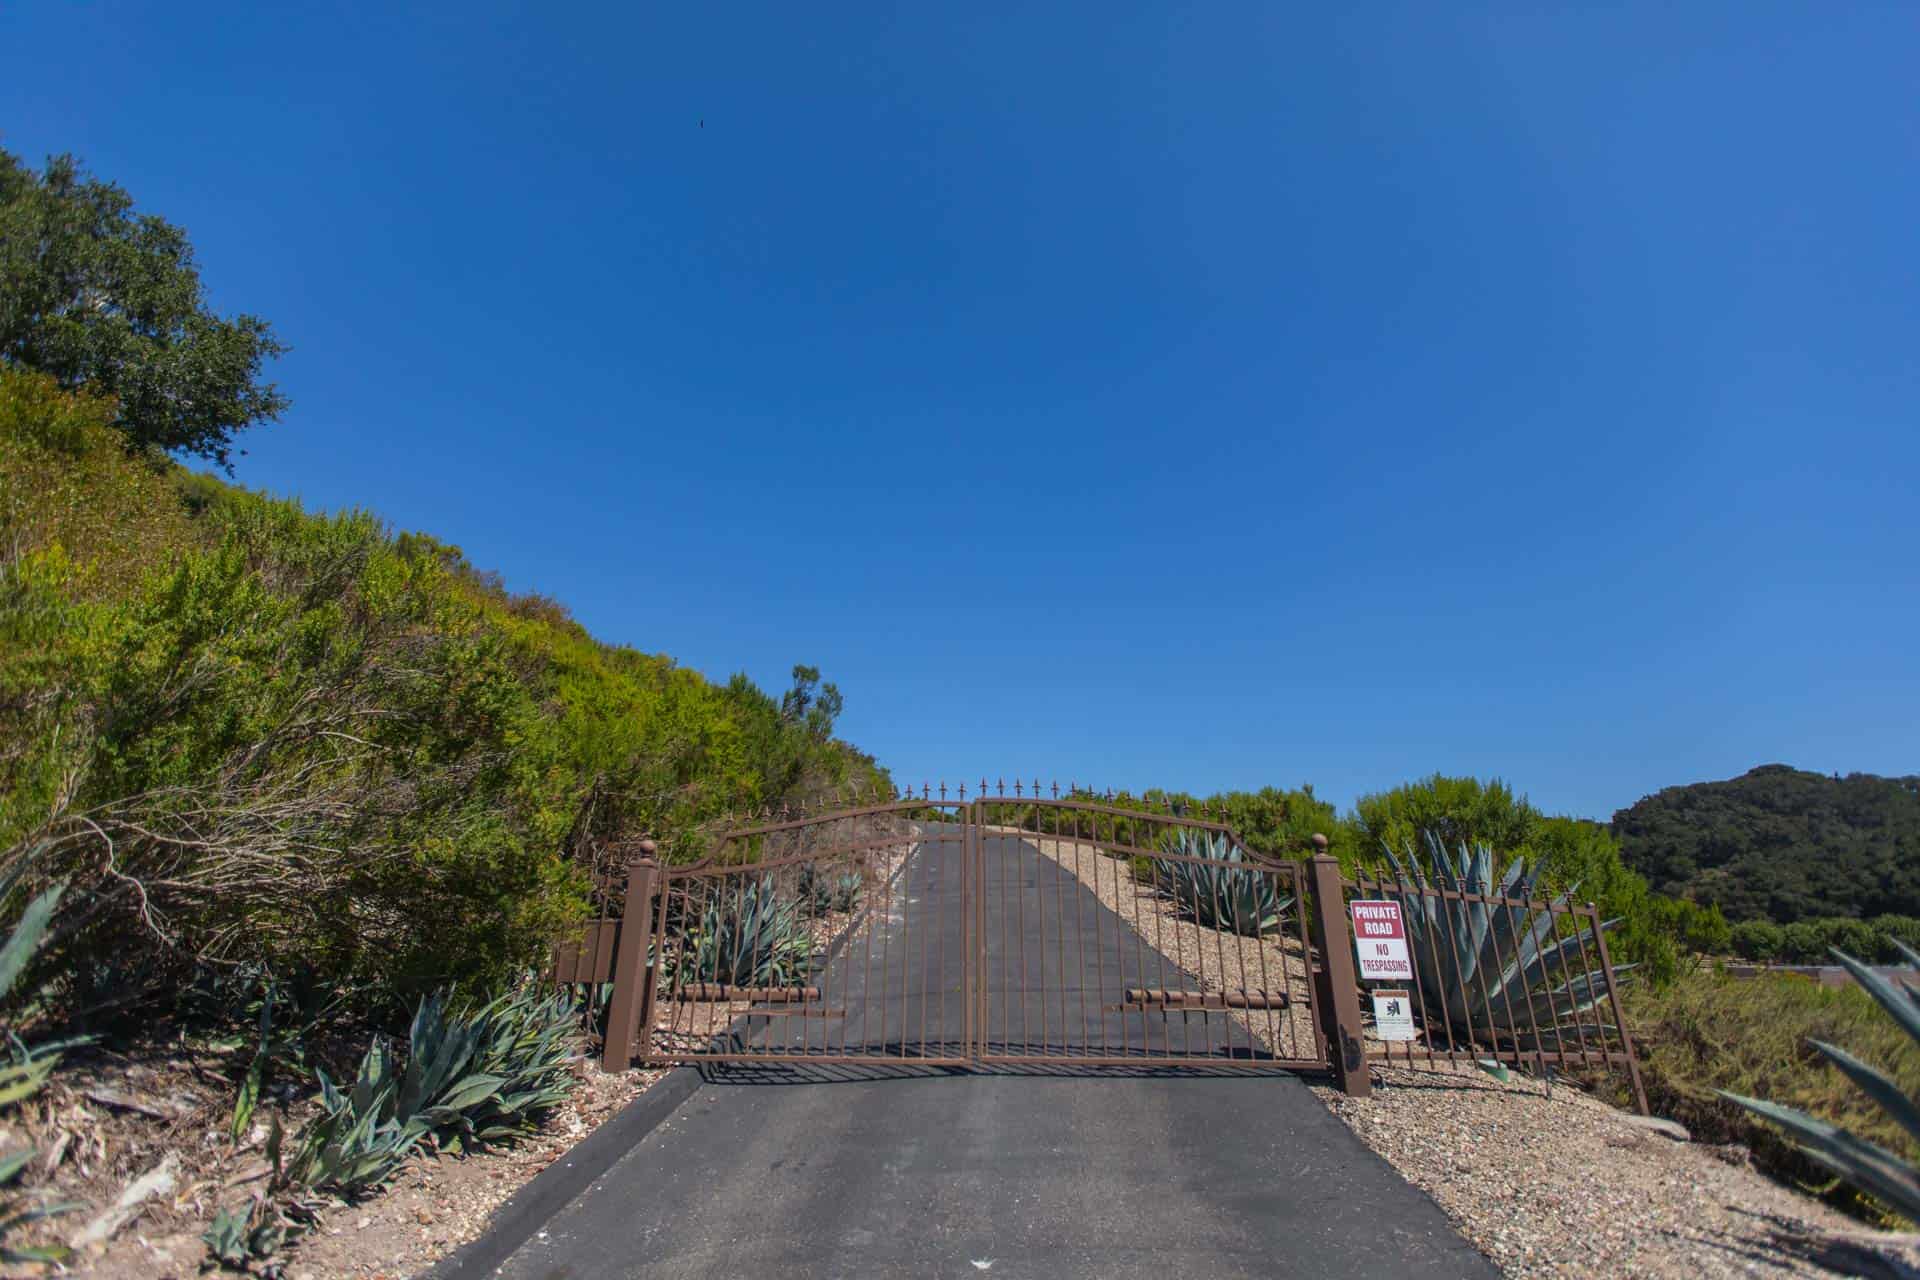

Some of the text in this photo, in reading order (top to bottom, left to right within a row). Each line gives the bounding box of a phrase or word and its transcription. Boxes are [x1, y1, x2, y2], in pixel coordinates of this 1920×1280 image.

[1355, 906, 1398, 919] PRIVATE
[1364, 922, 1392, 935] ROAD
[1376, 943, 1389, 956] NO
[1363, 959, 1408, 972] TRESPASSING
